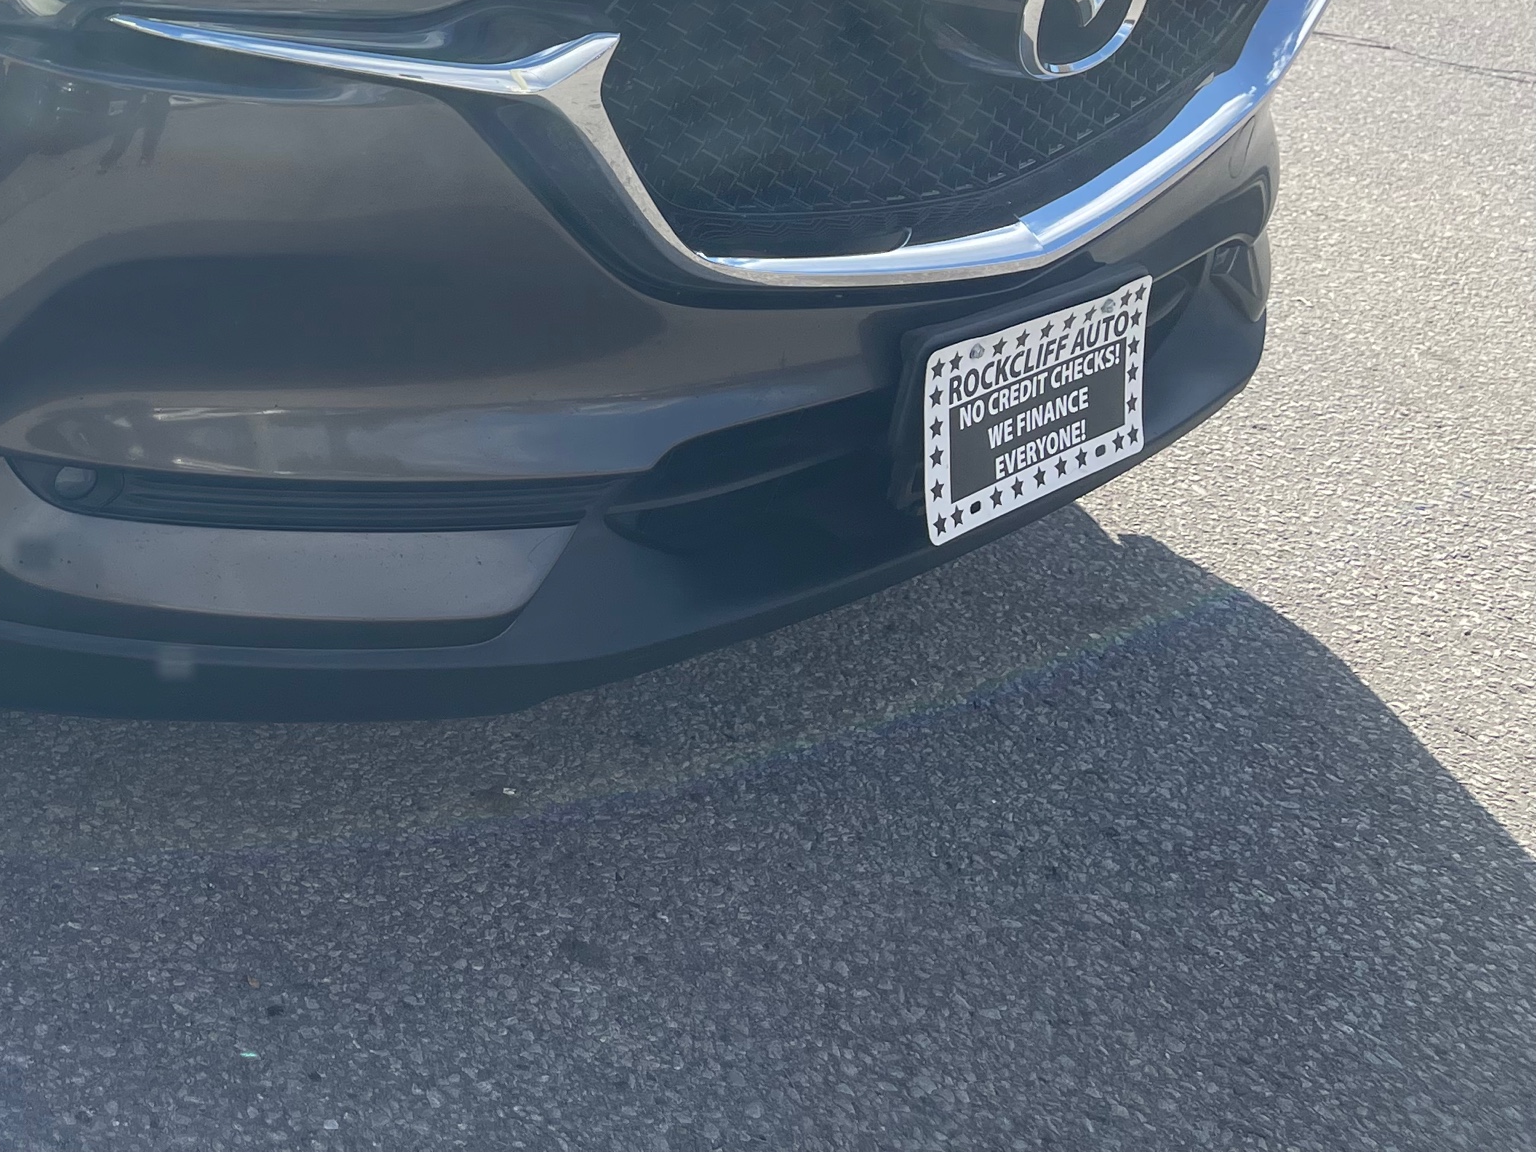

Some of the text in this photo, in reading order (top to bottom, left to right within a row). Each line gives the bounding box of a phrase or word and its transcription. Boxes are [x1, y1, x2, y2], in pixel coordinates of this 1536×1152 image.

[948, 310, 1129, 405] ROCKCLIFF AUTO
[959, 343, 1121, 430] NO CREDIT CHECKS!
[987, 386, 1089, 450] WE FINANCE
[994, 418, 1087, 480] EVERYONE!
